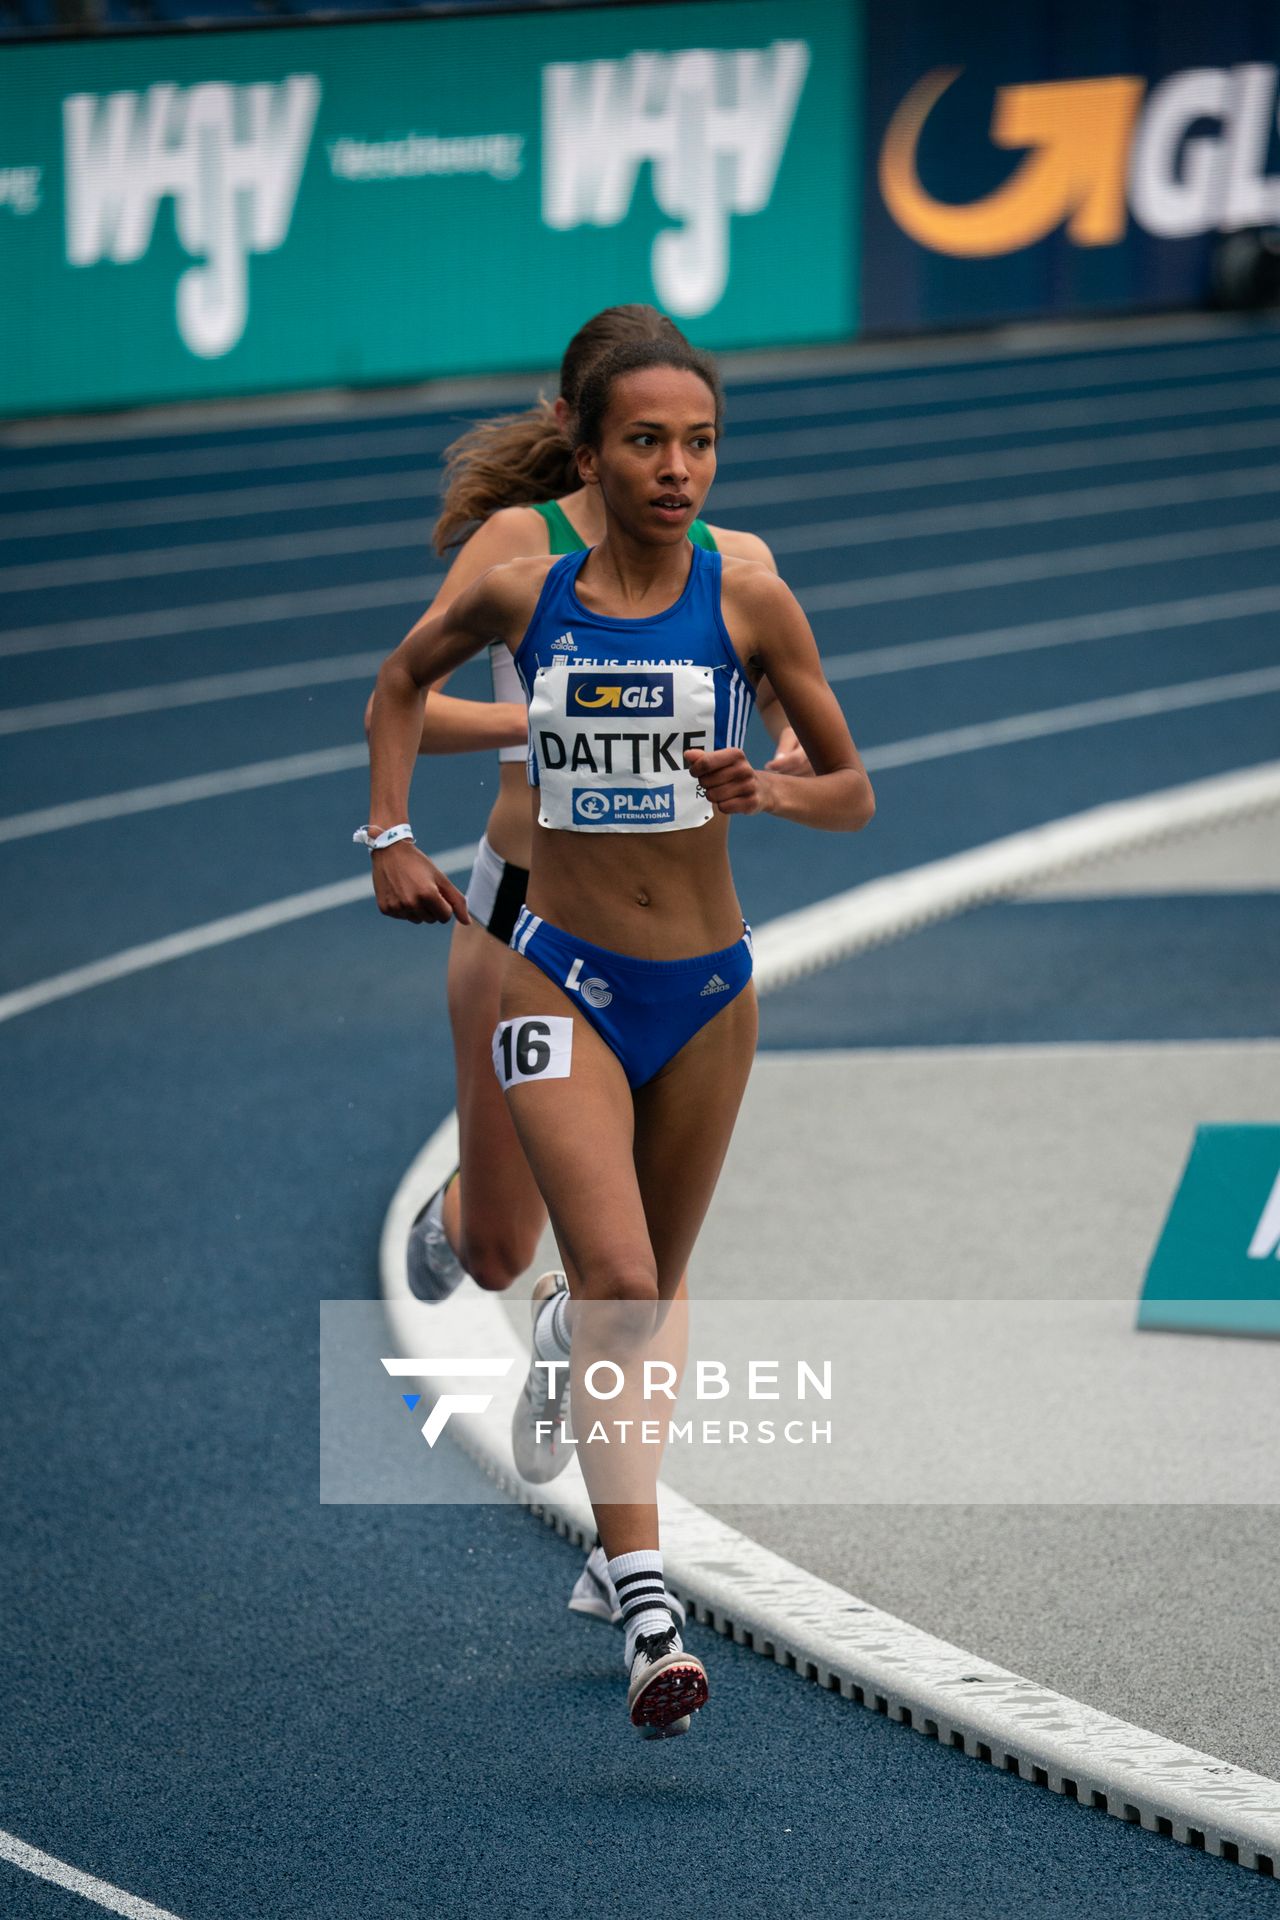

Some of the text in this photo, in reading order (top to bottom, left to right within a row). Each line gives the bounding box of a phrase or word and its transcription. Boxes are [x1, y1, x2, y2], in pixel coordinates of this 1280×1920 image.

[1128, 62, 1280, 238] GL
[551, 643, 578, 652] adidas
[622, 686, 664, 708] GLS
[614, 793, 670, 811] PLAN
[614, 811, 671, 820] INTERNATIONAL
[700, 983, 730, 997] adidas
[498, 1021, 551, 1082] 16
